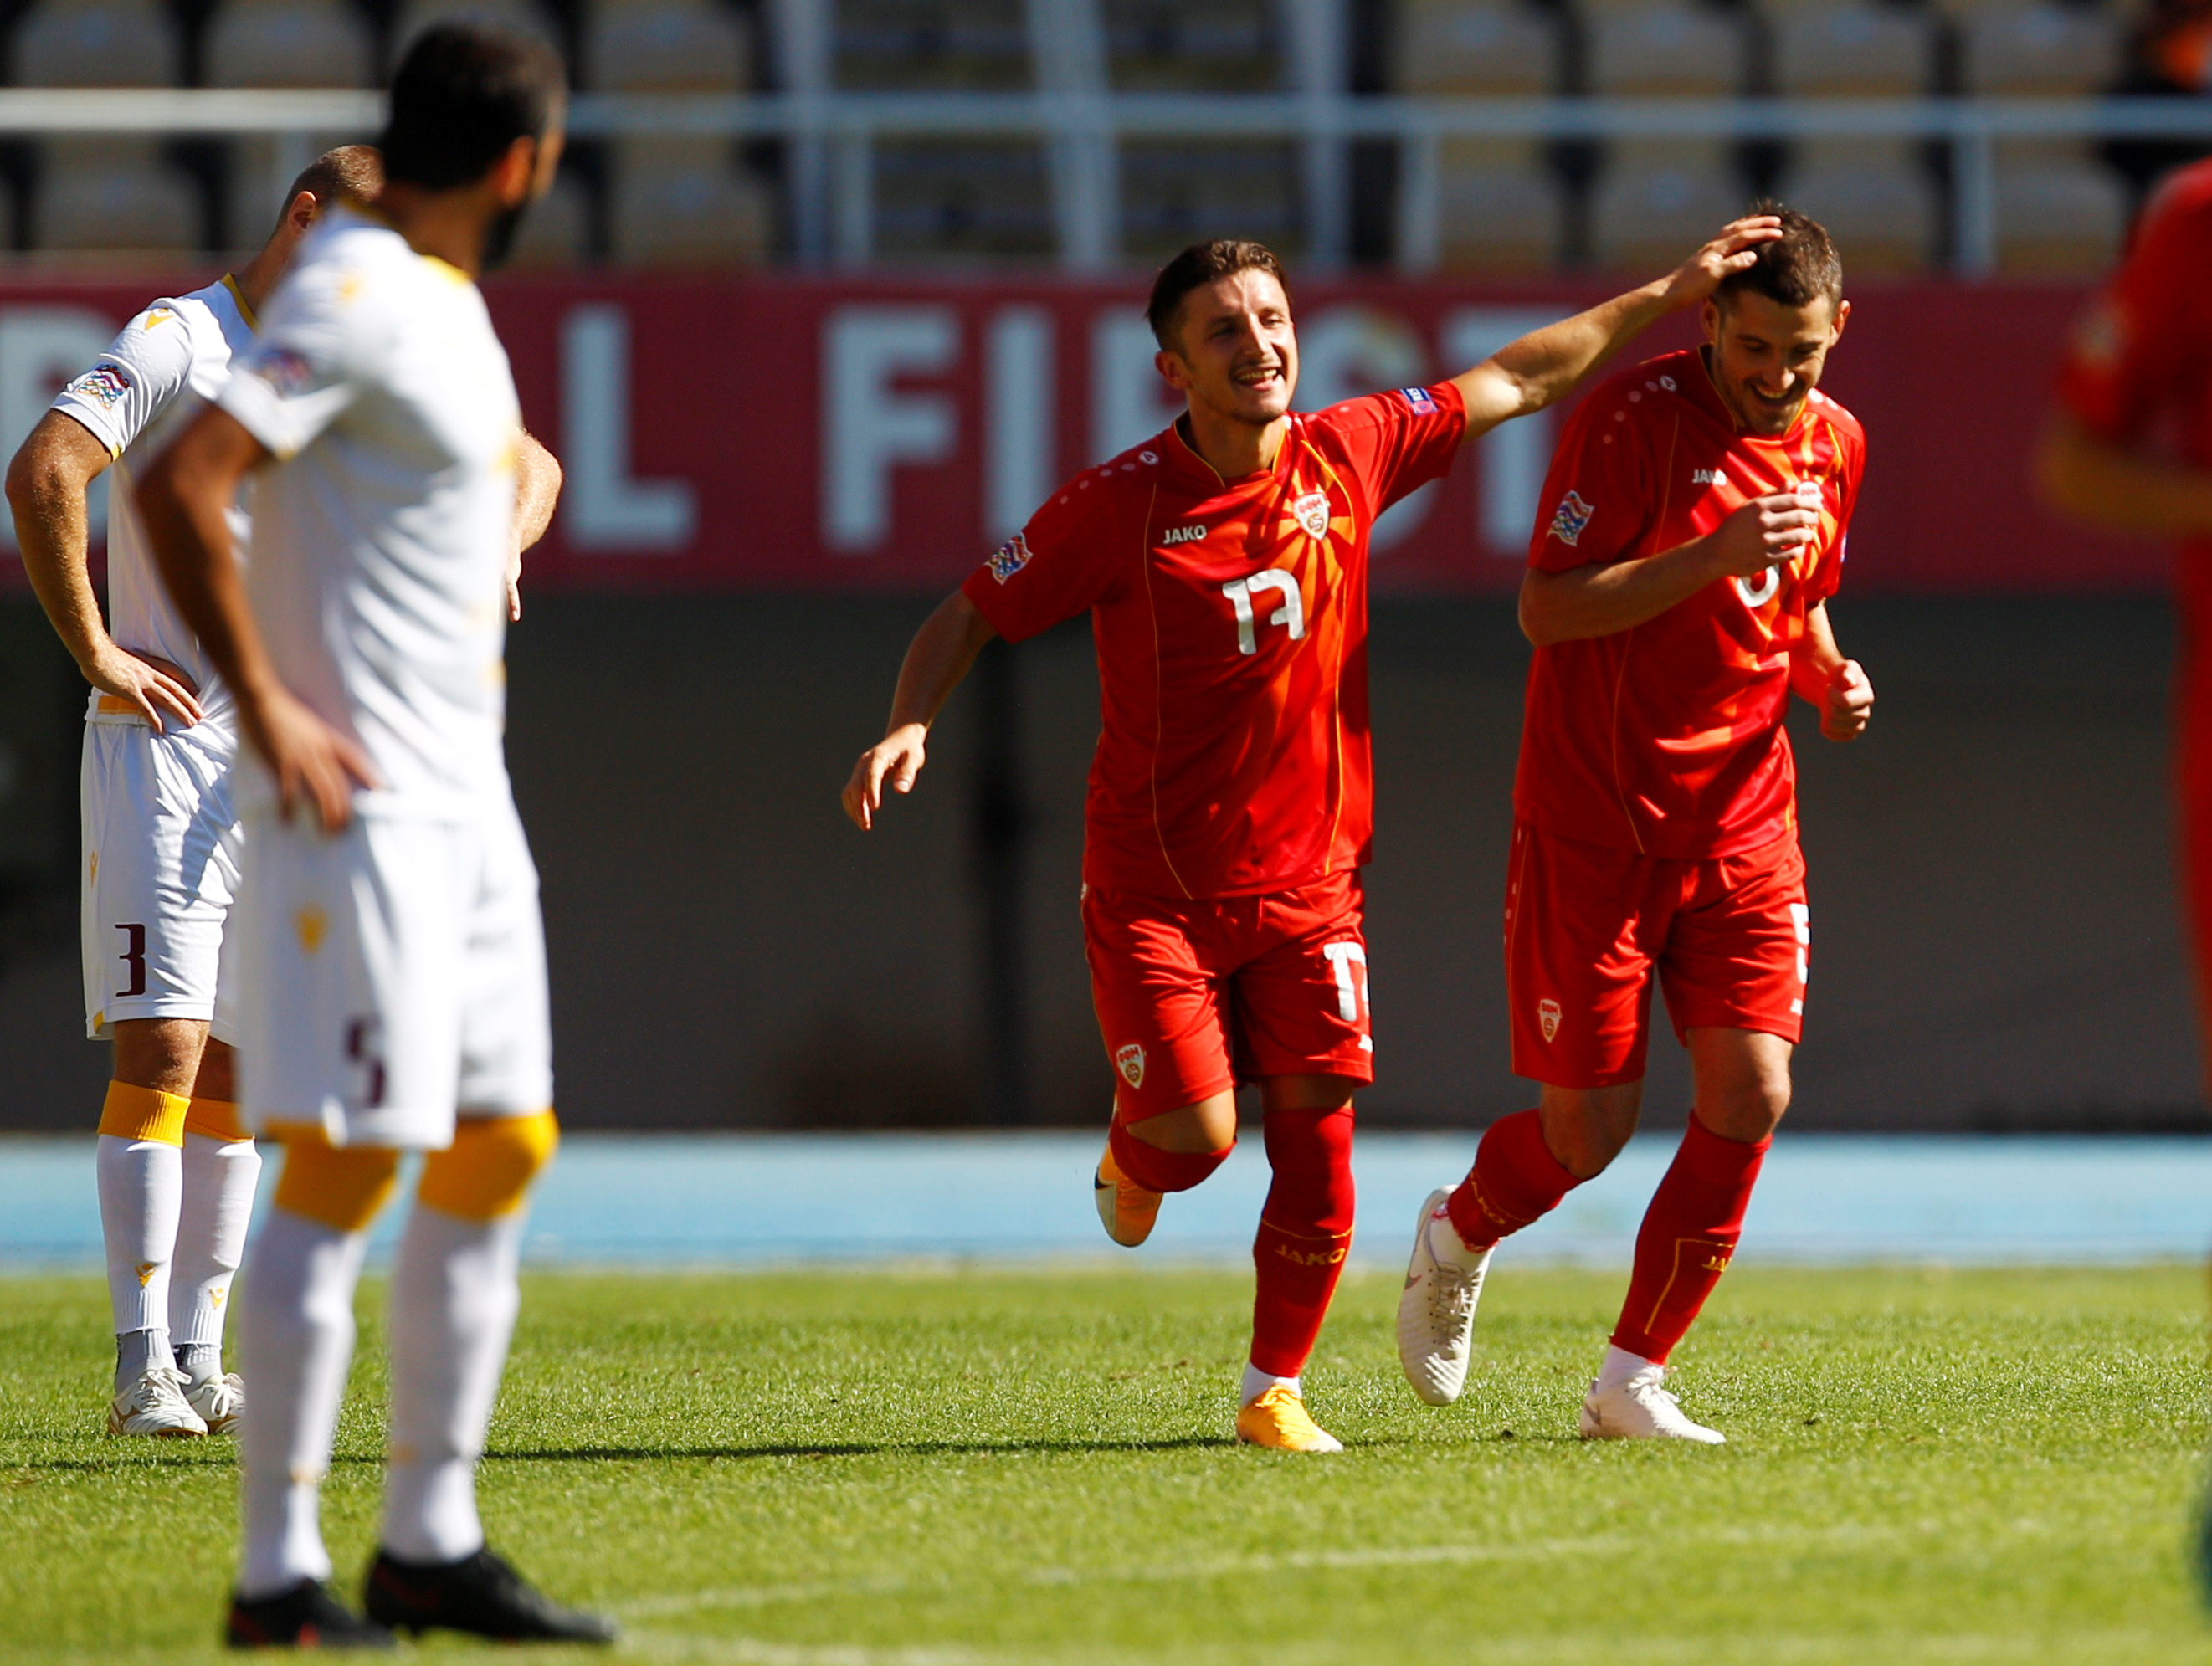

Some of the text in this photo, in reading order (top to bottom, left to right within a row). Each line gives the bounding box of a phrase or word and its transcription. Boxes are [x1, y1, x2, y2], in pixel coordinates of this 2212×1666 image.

[1162, 524, 1207, 544] JAKO
[1222, 567, 1306, 655] 17
[114, 923, 146, 997] 3
[1275, 1244, 1346, 1265] JAKO
